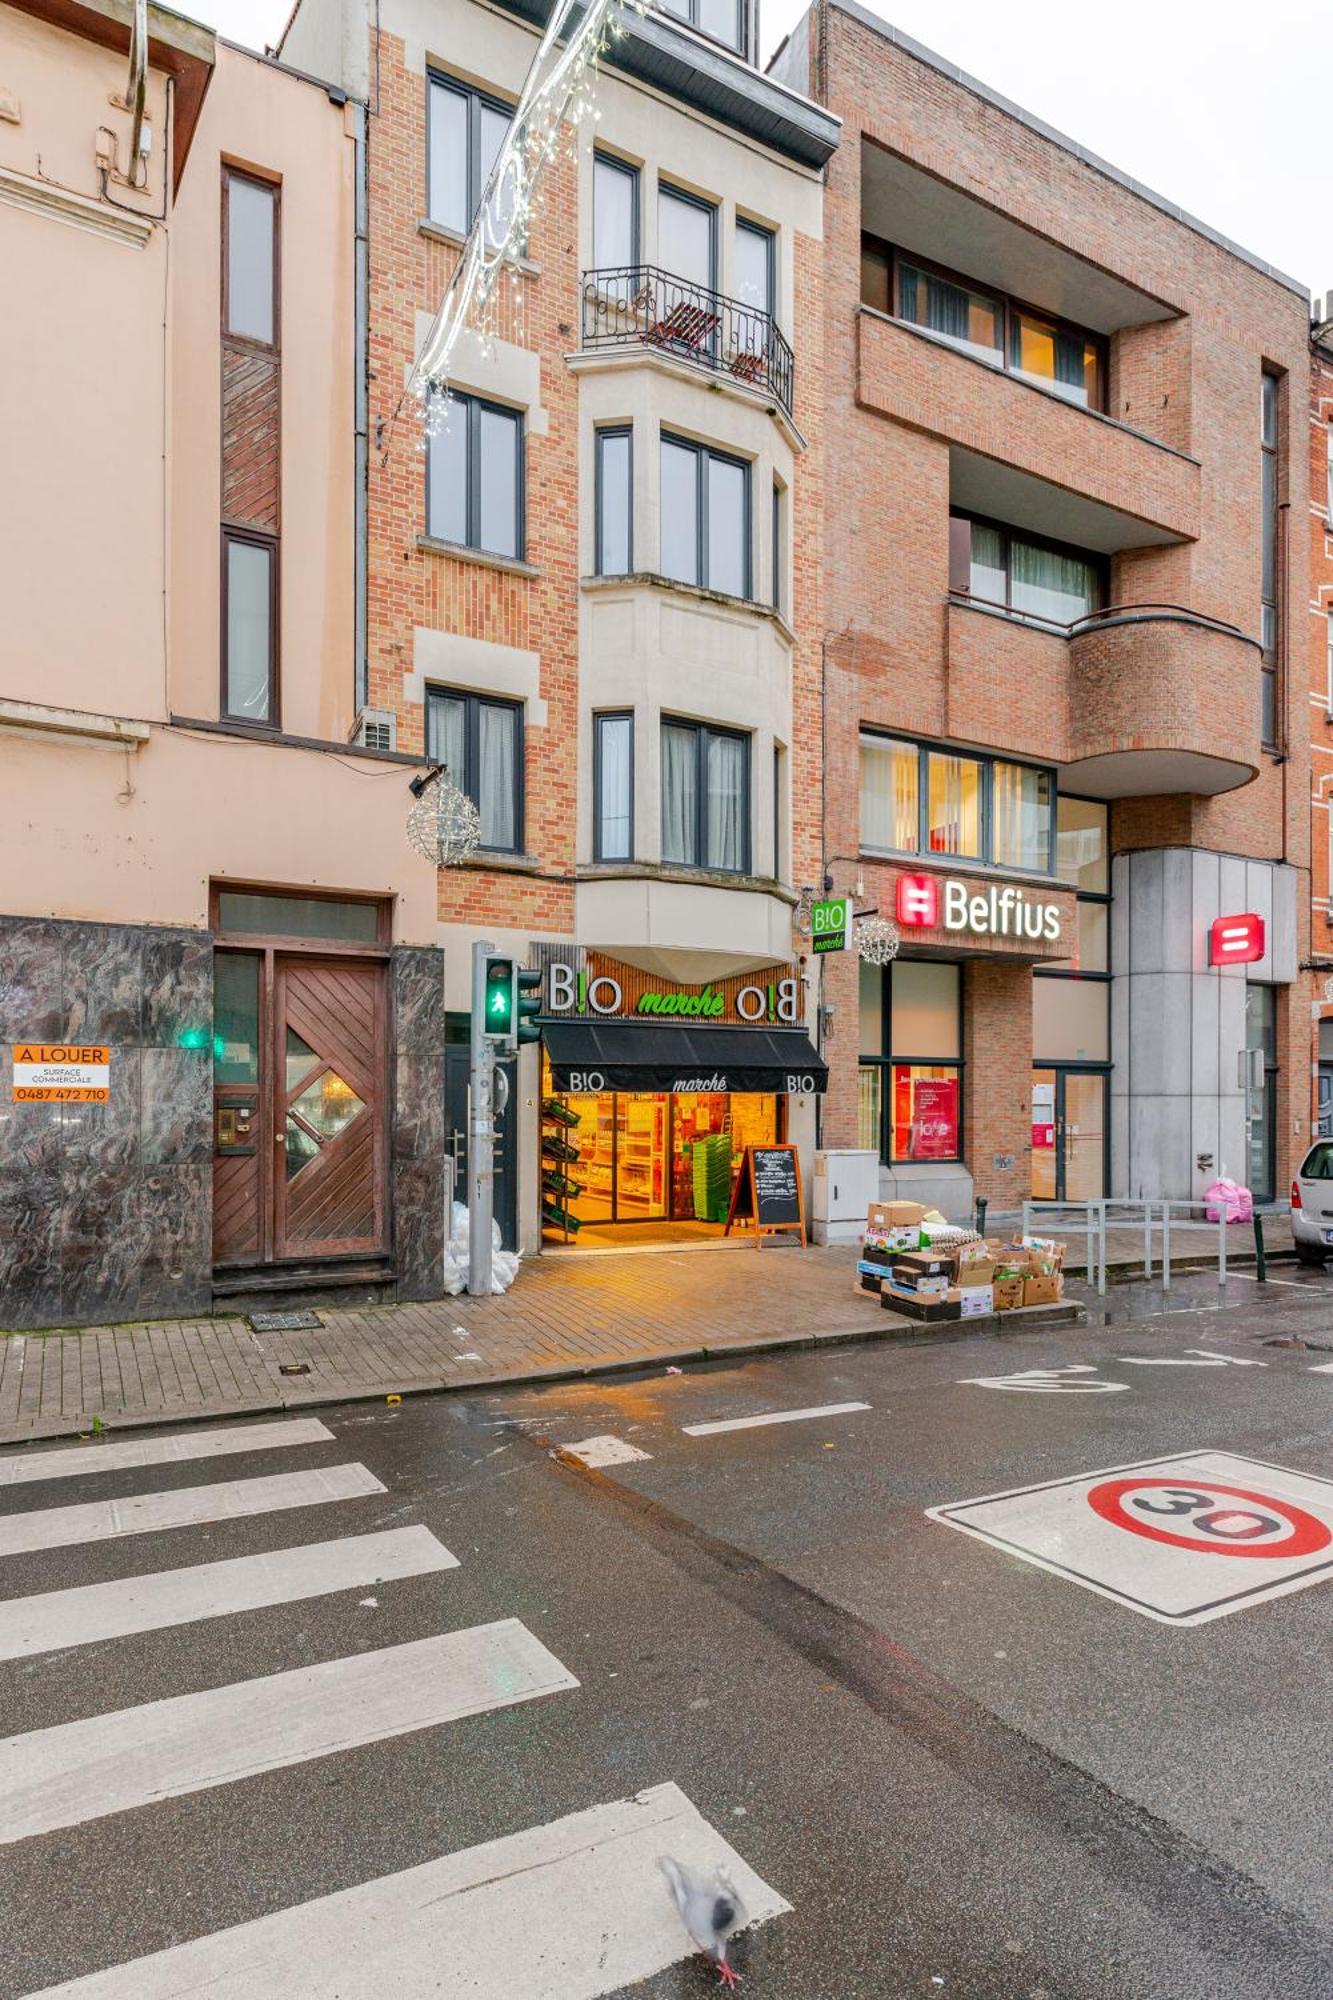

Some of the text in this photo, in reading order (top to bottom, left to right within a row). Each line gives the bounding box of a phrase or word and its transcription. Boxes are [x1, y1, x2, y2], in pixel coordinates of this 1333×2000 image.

[945, 881, 1061, 940] Belfius
[637, 984, 726, 1017] marché
[20, 1048, 104, 1063] A LOUER
[43, 1068, 81, 1076] SURFACE
[672, 1072, 728, 1093] marché
[17, 1089, 105, 1100] 0487 472 710
[1132, 1489, 1281, 1540] 30
